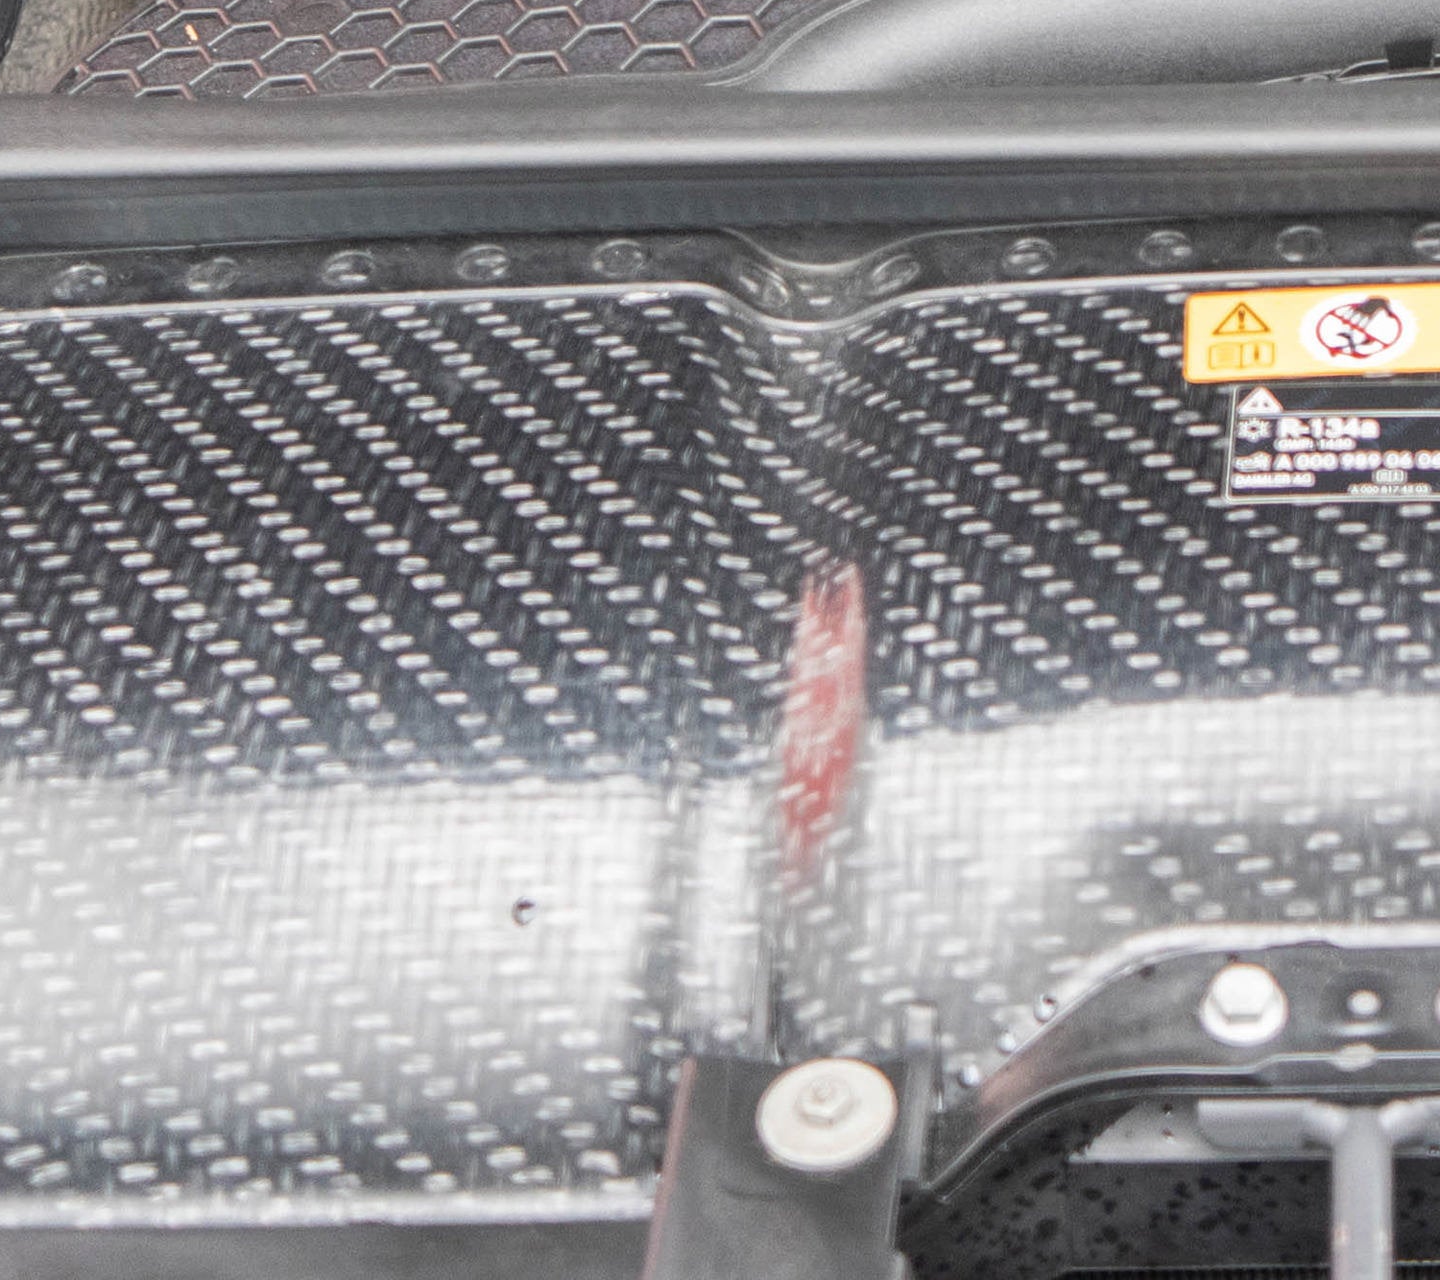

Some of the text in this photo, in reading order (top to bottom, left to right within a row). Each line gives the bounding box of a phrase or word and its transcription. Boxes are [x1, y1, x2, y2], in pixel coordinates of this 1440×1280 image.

[1277, 417, 1380, 439] R-134a
[1273, 452, 1293, 471] A
[1293, 451, 1338, 471] 000
[1232, 472, 1291, 488] DAIMLER
[1291, 471, 1315, 487] AG
